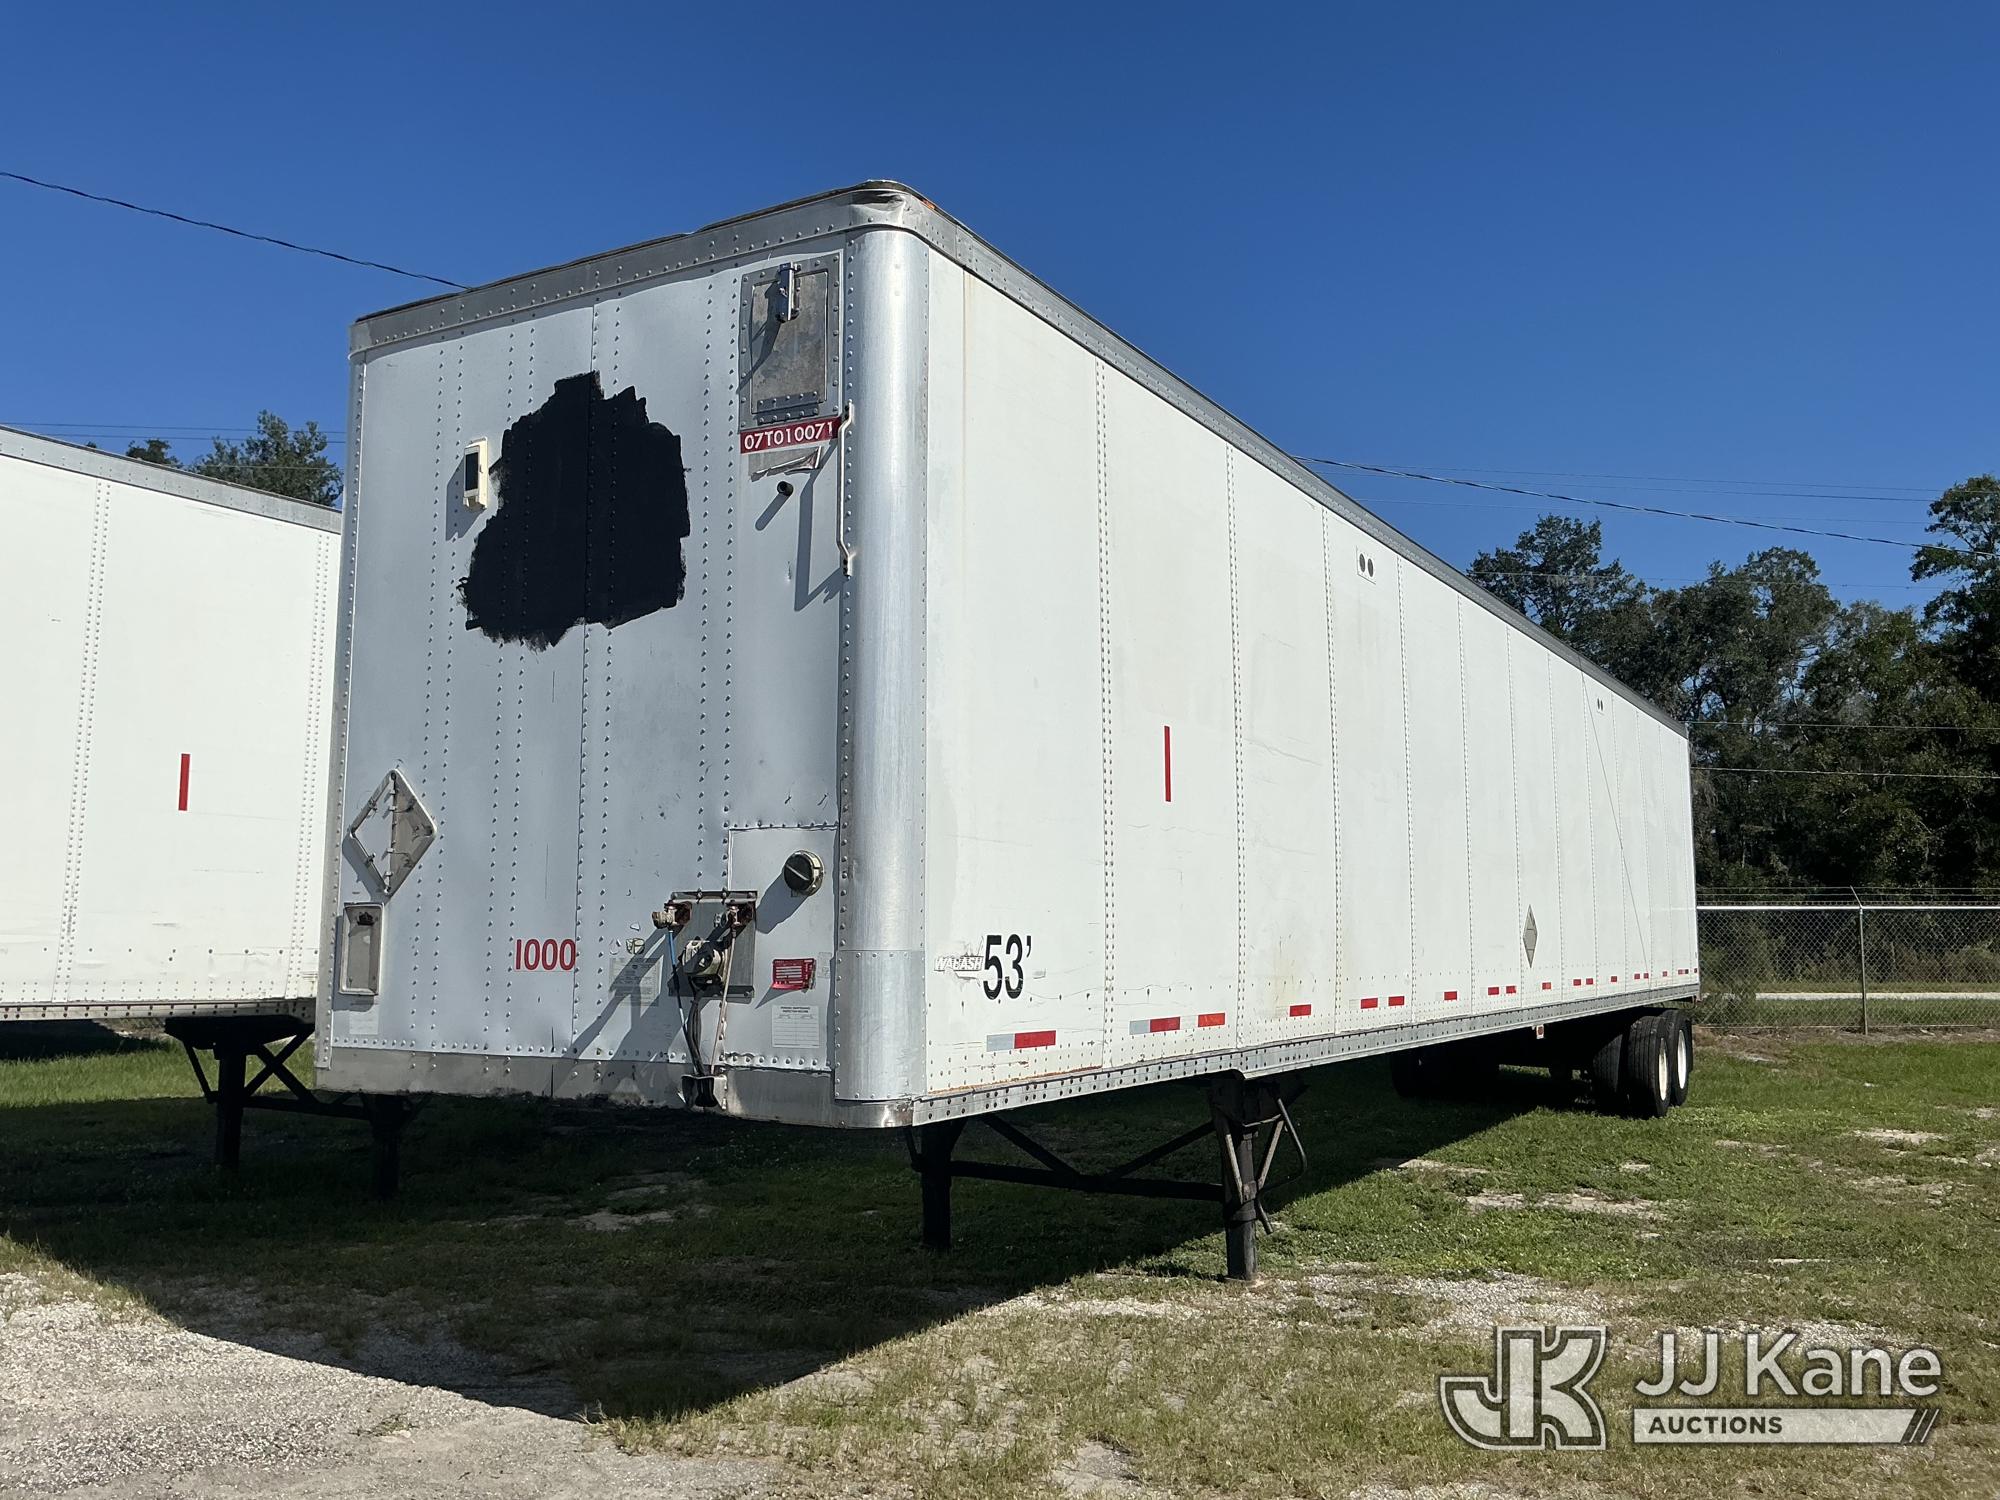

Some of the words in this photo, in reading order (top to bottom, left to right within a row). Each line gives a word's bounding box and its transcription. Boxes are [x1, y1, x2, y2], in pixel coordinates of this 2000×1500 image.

[744, 422, 834, 450] 07T010071
[516, 939, 576, 970] 1000
[935, 956, 983, 971] WABASH
[983, 934, 1032, 1000] 53'
